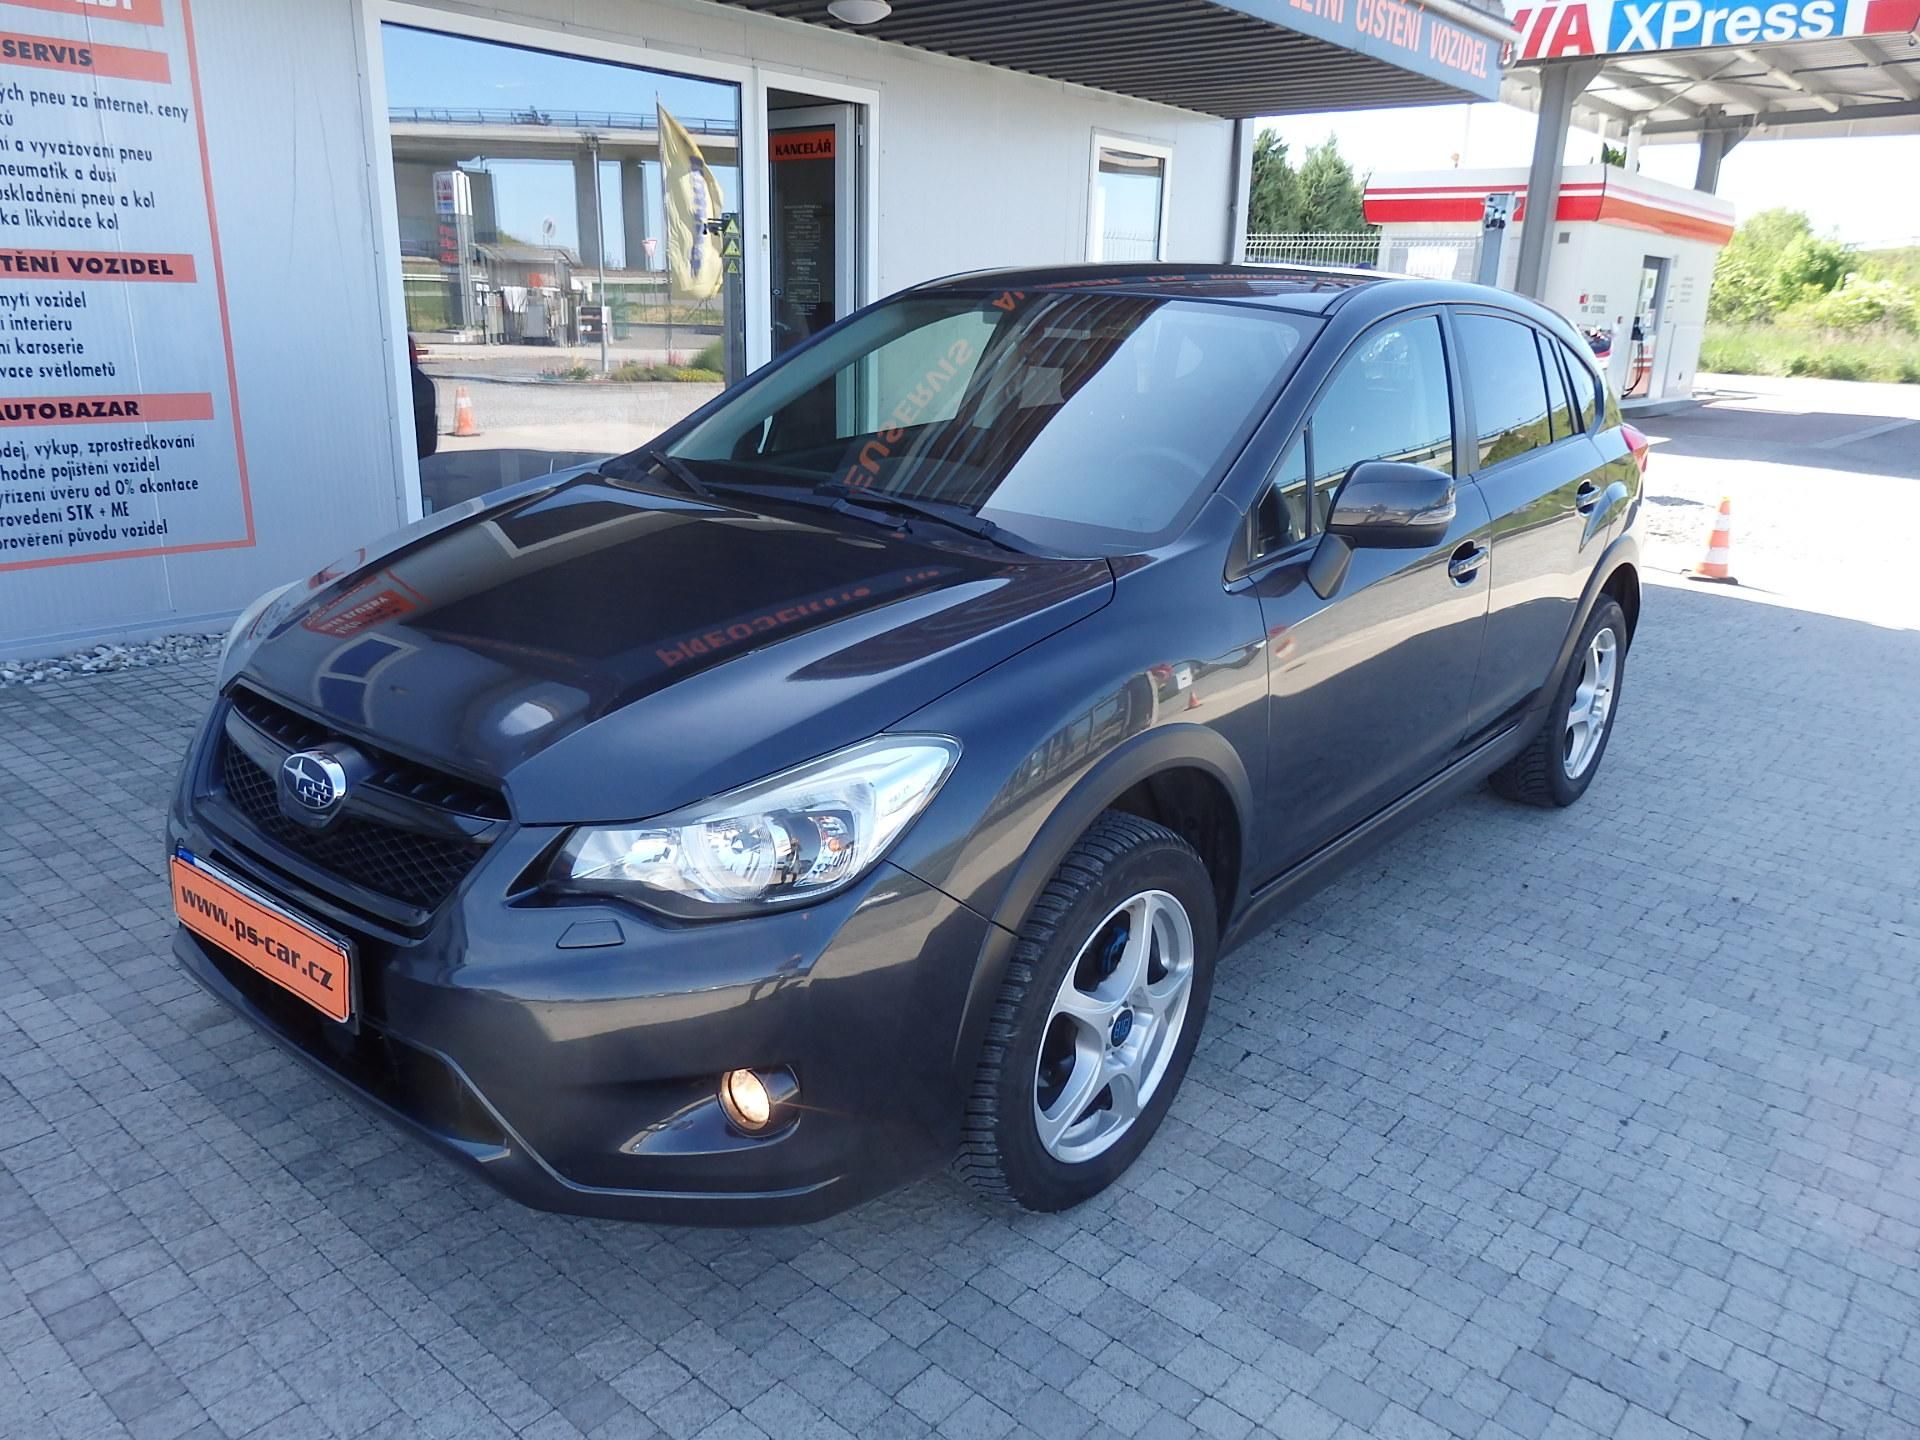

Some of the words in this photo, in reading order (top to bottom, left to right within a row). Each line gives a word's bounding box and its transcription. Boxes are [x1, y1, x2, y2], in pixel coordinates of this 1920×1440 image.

[1616, 0, 1836, 53] XPress
[1429, 20, 1489, 79] VOZIDEL
[30, 90, 66, 107] pneu
[72, 94, 88, 108] za
[93, 91, 154, 116] internet.
[157, 104, 189, 123] ceny
[15, 139, 24, 152] a
[29, 140, 115, 159] vyvažování
[119, 148, 153, 164] pneu
[75, 168, 83, 180] a
[0, 182, 76, 205] skladnění
[81, 192, 115, 209] pneu
[120, 195, 129, 207] a
[133, 190, 155, 208] kol
[25, 208, 92, 229] likvidace
[96, 211, 119, 230] kol
[67, 256, 174, 276] VOZIDEL
[35, 290, 87, 308] vozidel
[8, 313, 73, 331] interiéru
[15, 336, 84, 355] karoserie
[39, 360, 116, 378] světlometů
[87, 433, 195, 457] zprostředkování
[51, 459, 109, 483] pojištění
[112, 455, 160, 473] vozidel
[50, 484, 90, 501] úvěru
[94, 480, 111, 497] od
[115, 479, 135, 496] 0%
[139, 477, 199, 494] akontace
[66, 504, 94, 521] STK
[111, 500, 130, 518] ME
[67, 523, 117, 547] původu
[121, 518, 168, 538] vozidel
[181, 885, 334, 991] www.ps-car.cz
